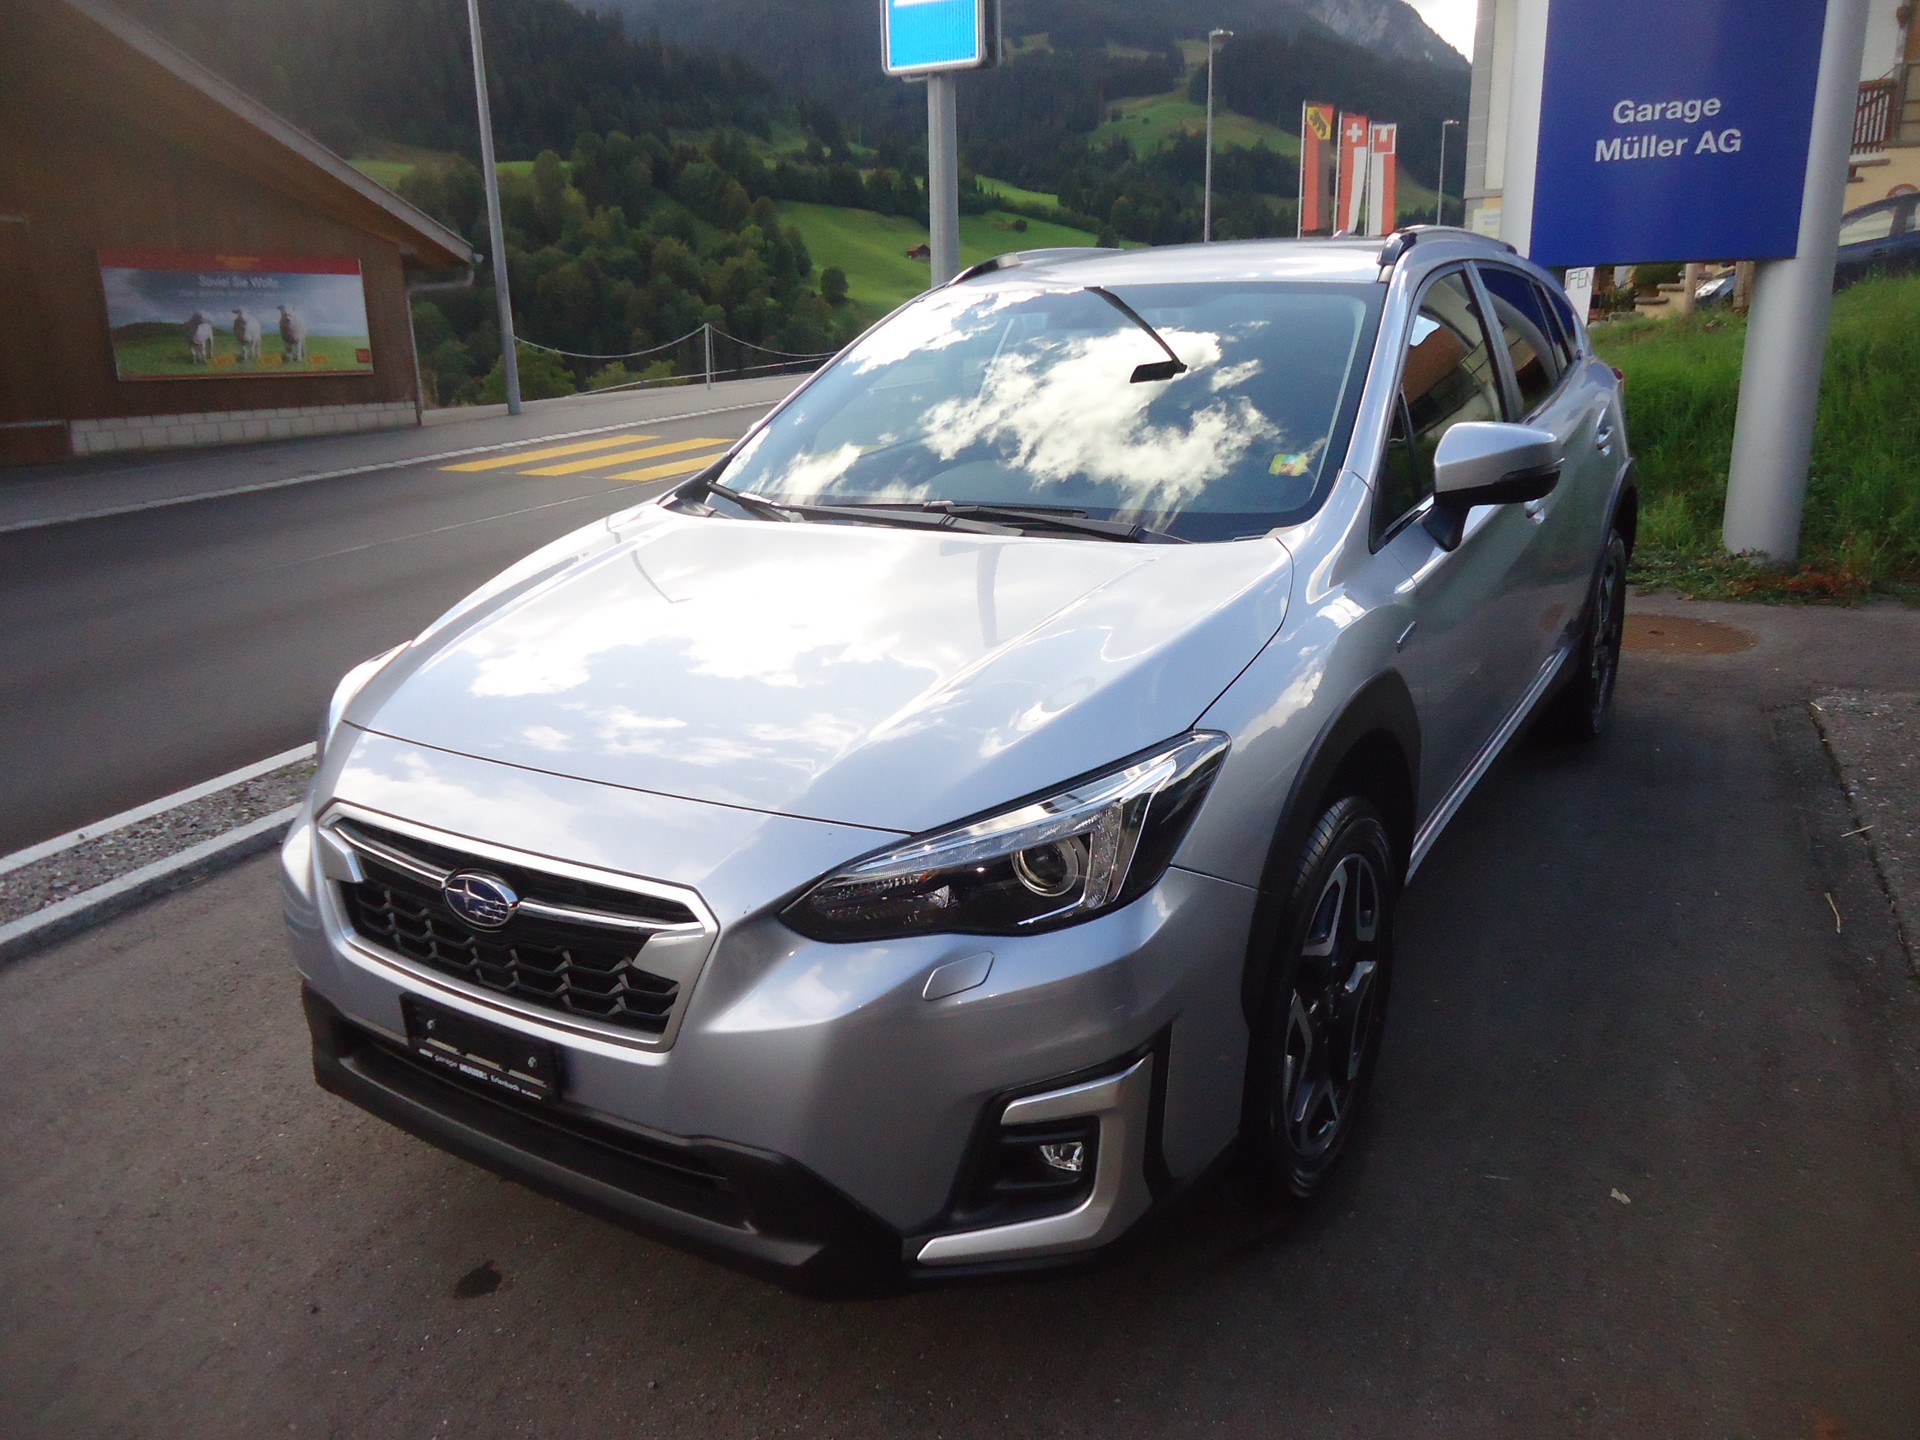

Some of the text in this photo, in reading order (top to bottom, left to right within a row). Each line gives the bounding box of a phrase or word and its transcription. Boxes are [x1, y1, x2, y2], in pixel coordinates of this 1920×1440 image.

[1612, 97, 1722, 124] Garage
[1594, 128, 1742, 162] Müller AG
